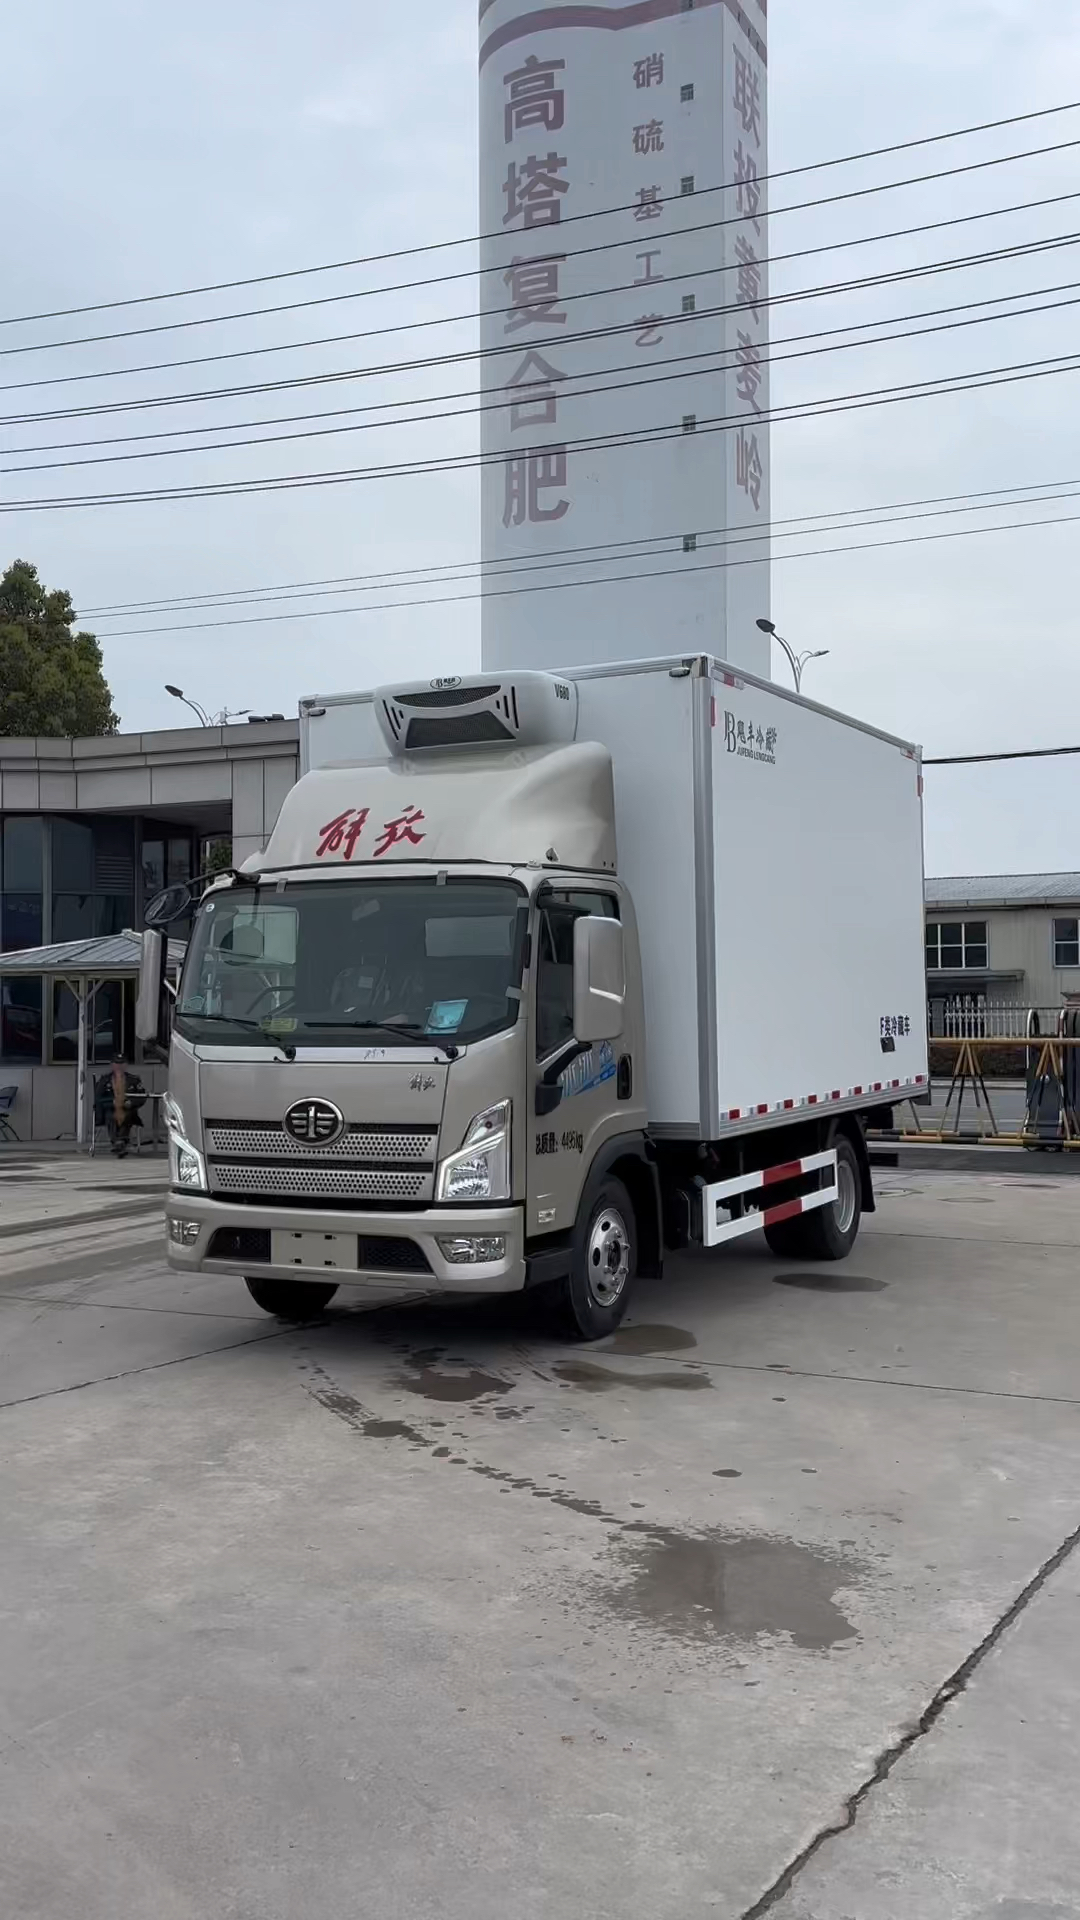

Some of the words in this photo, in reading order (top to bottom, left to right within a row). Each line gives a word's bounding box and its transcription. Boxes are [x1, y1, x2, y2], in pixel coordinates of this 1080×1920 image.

[502, 54, 570, 529] 高塔复合肥
[632, 52, 665, 349] 硝硫基工艺
[732, 42, 763, 513] 联投黄麦岭
[316, 804, 428, 860] 解放
[880, 1014, 911, 1037] F类冷藏车
